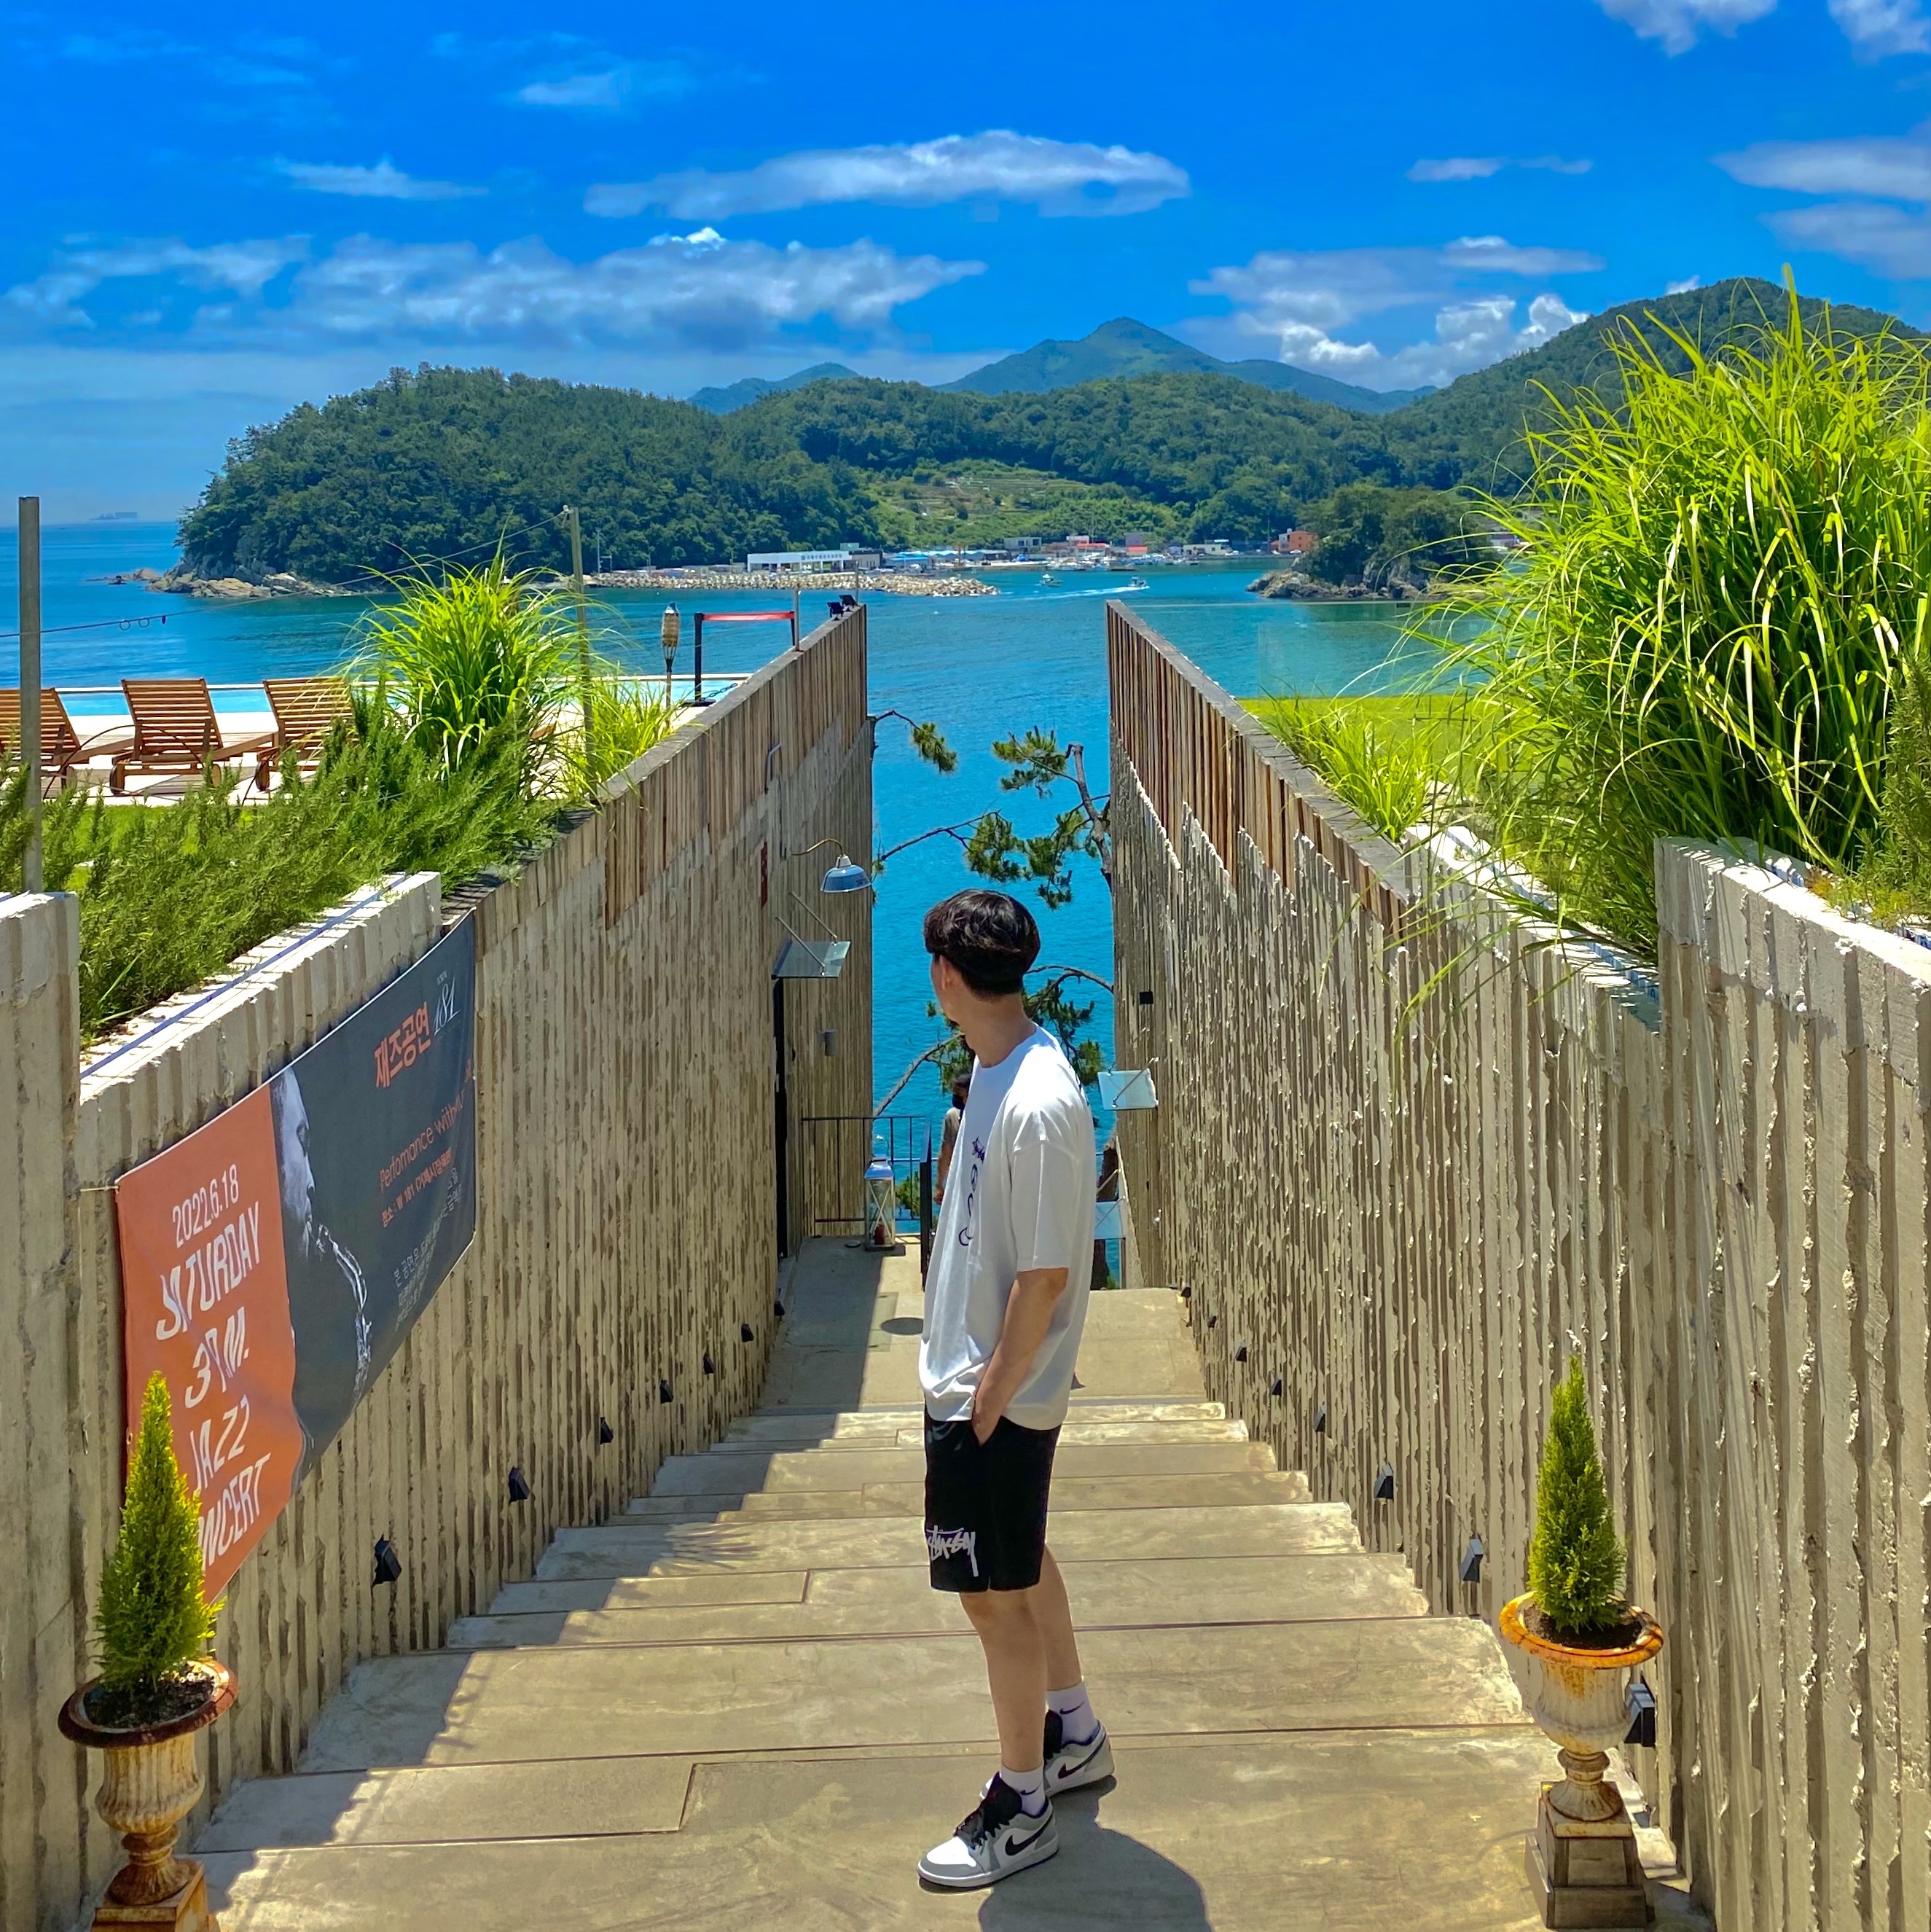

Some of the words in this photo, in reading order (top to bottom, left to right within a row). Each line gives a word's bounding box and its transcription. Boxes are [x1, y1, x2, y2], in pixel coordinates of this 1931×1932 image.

[374, 1001, 431, 1088] 재즈공연
[171, 1164, 239, 1248] 2022.6.18
[189, 1394, 250, 1499] JAZZ
[197, 1452, 272, 1572] NCERT
